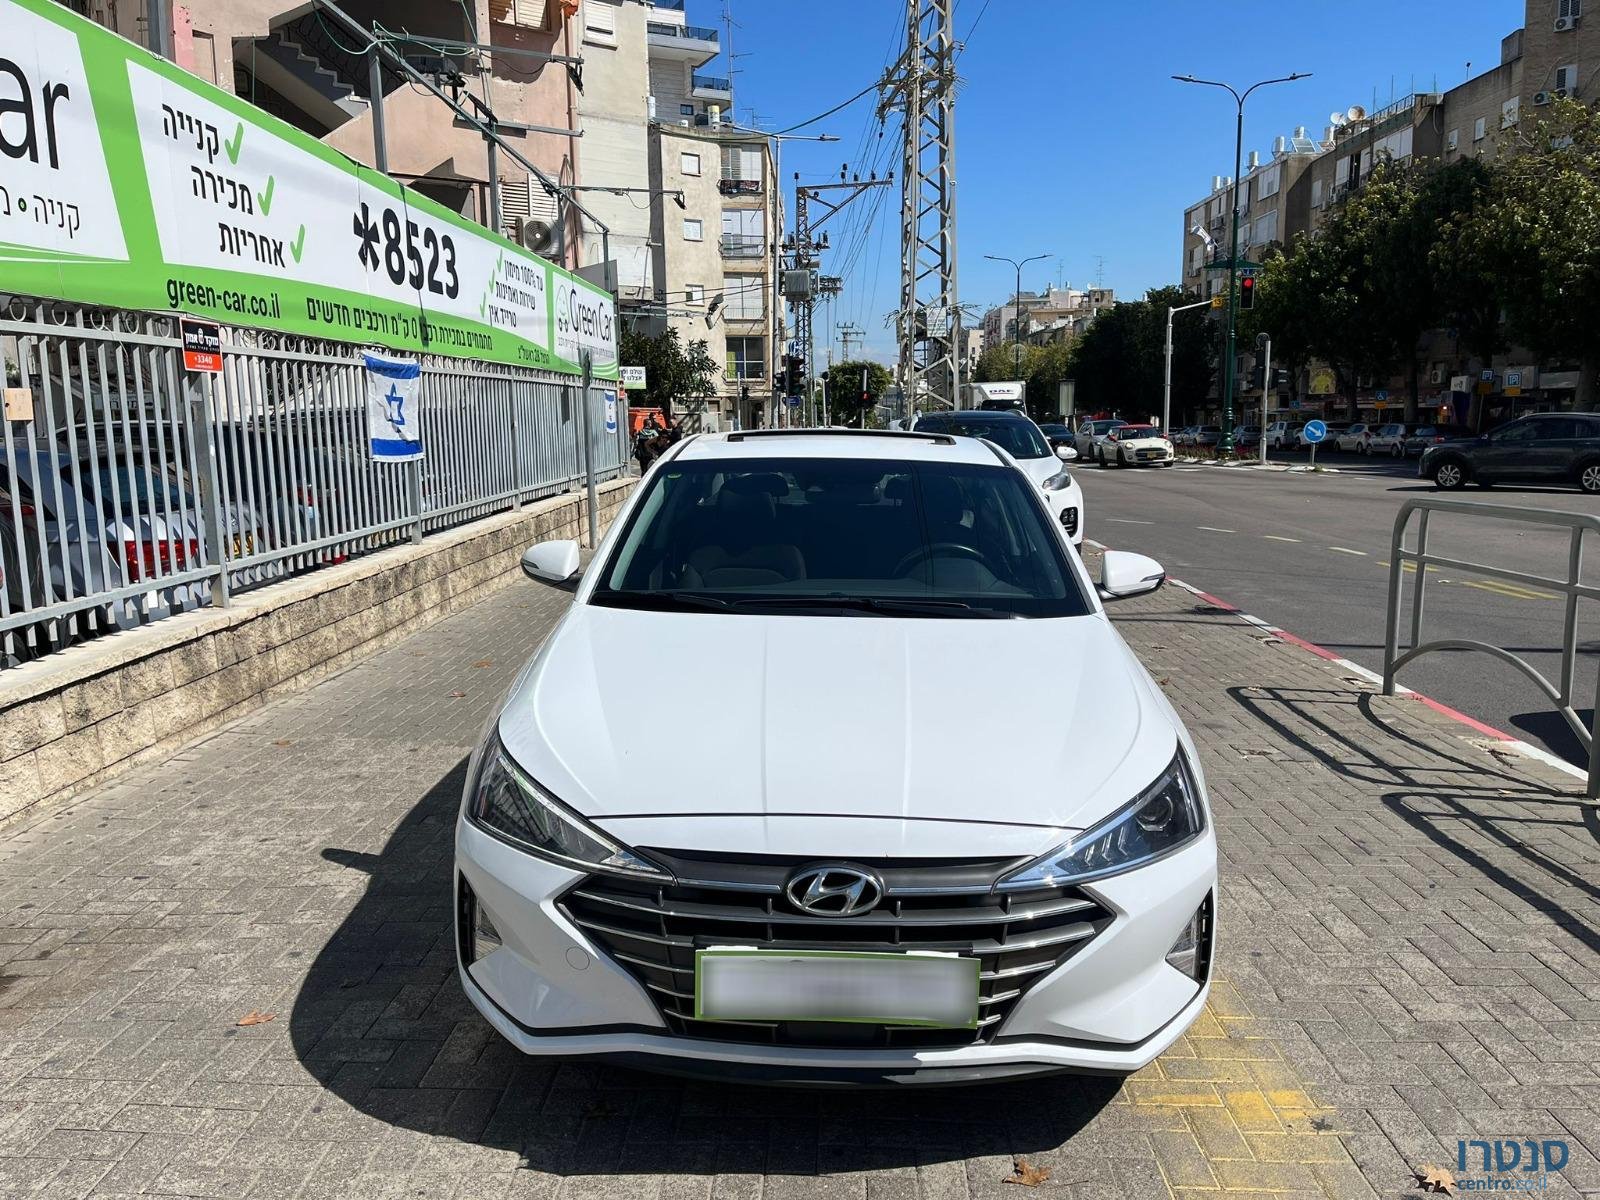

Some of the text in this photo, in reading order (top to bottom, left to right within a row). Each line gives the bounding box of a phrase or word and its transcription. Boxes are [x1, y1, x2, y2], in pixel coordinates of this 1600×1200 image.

[162, 103, 220, 164] קנייה
[191, 165, 253, 215] מכירה
[33, 194, 80, 239] קניה
[218, 222, 286, 268] אחריות
[166, 279, 281, 319] green-car.co.il
[496, 281, 536, 310] שירות ואמינות
[306, 297, 351, 327] חדשים
[353, 307, 389, 334] ורכבים
[488, 304, 517, 327] טרייד אין
[439, 326, 466, 346] במכירת
[467, 331, 493, 350] מתמחים
